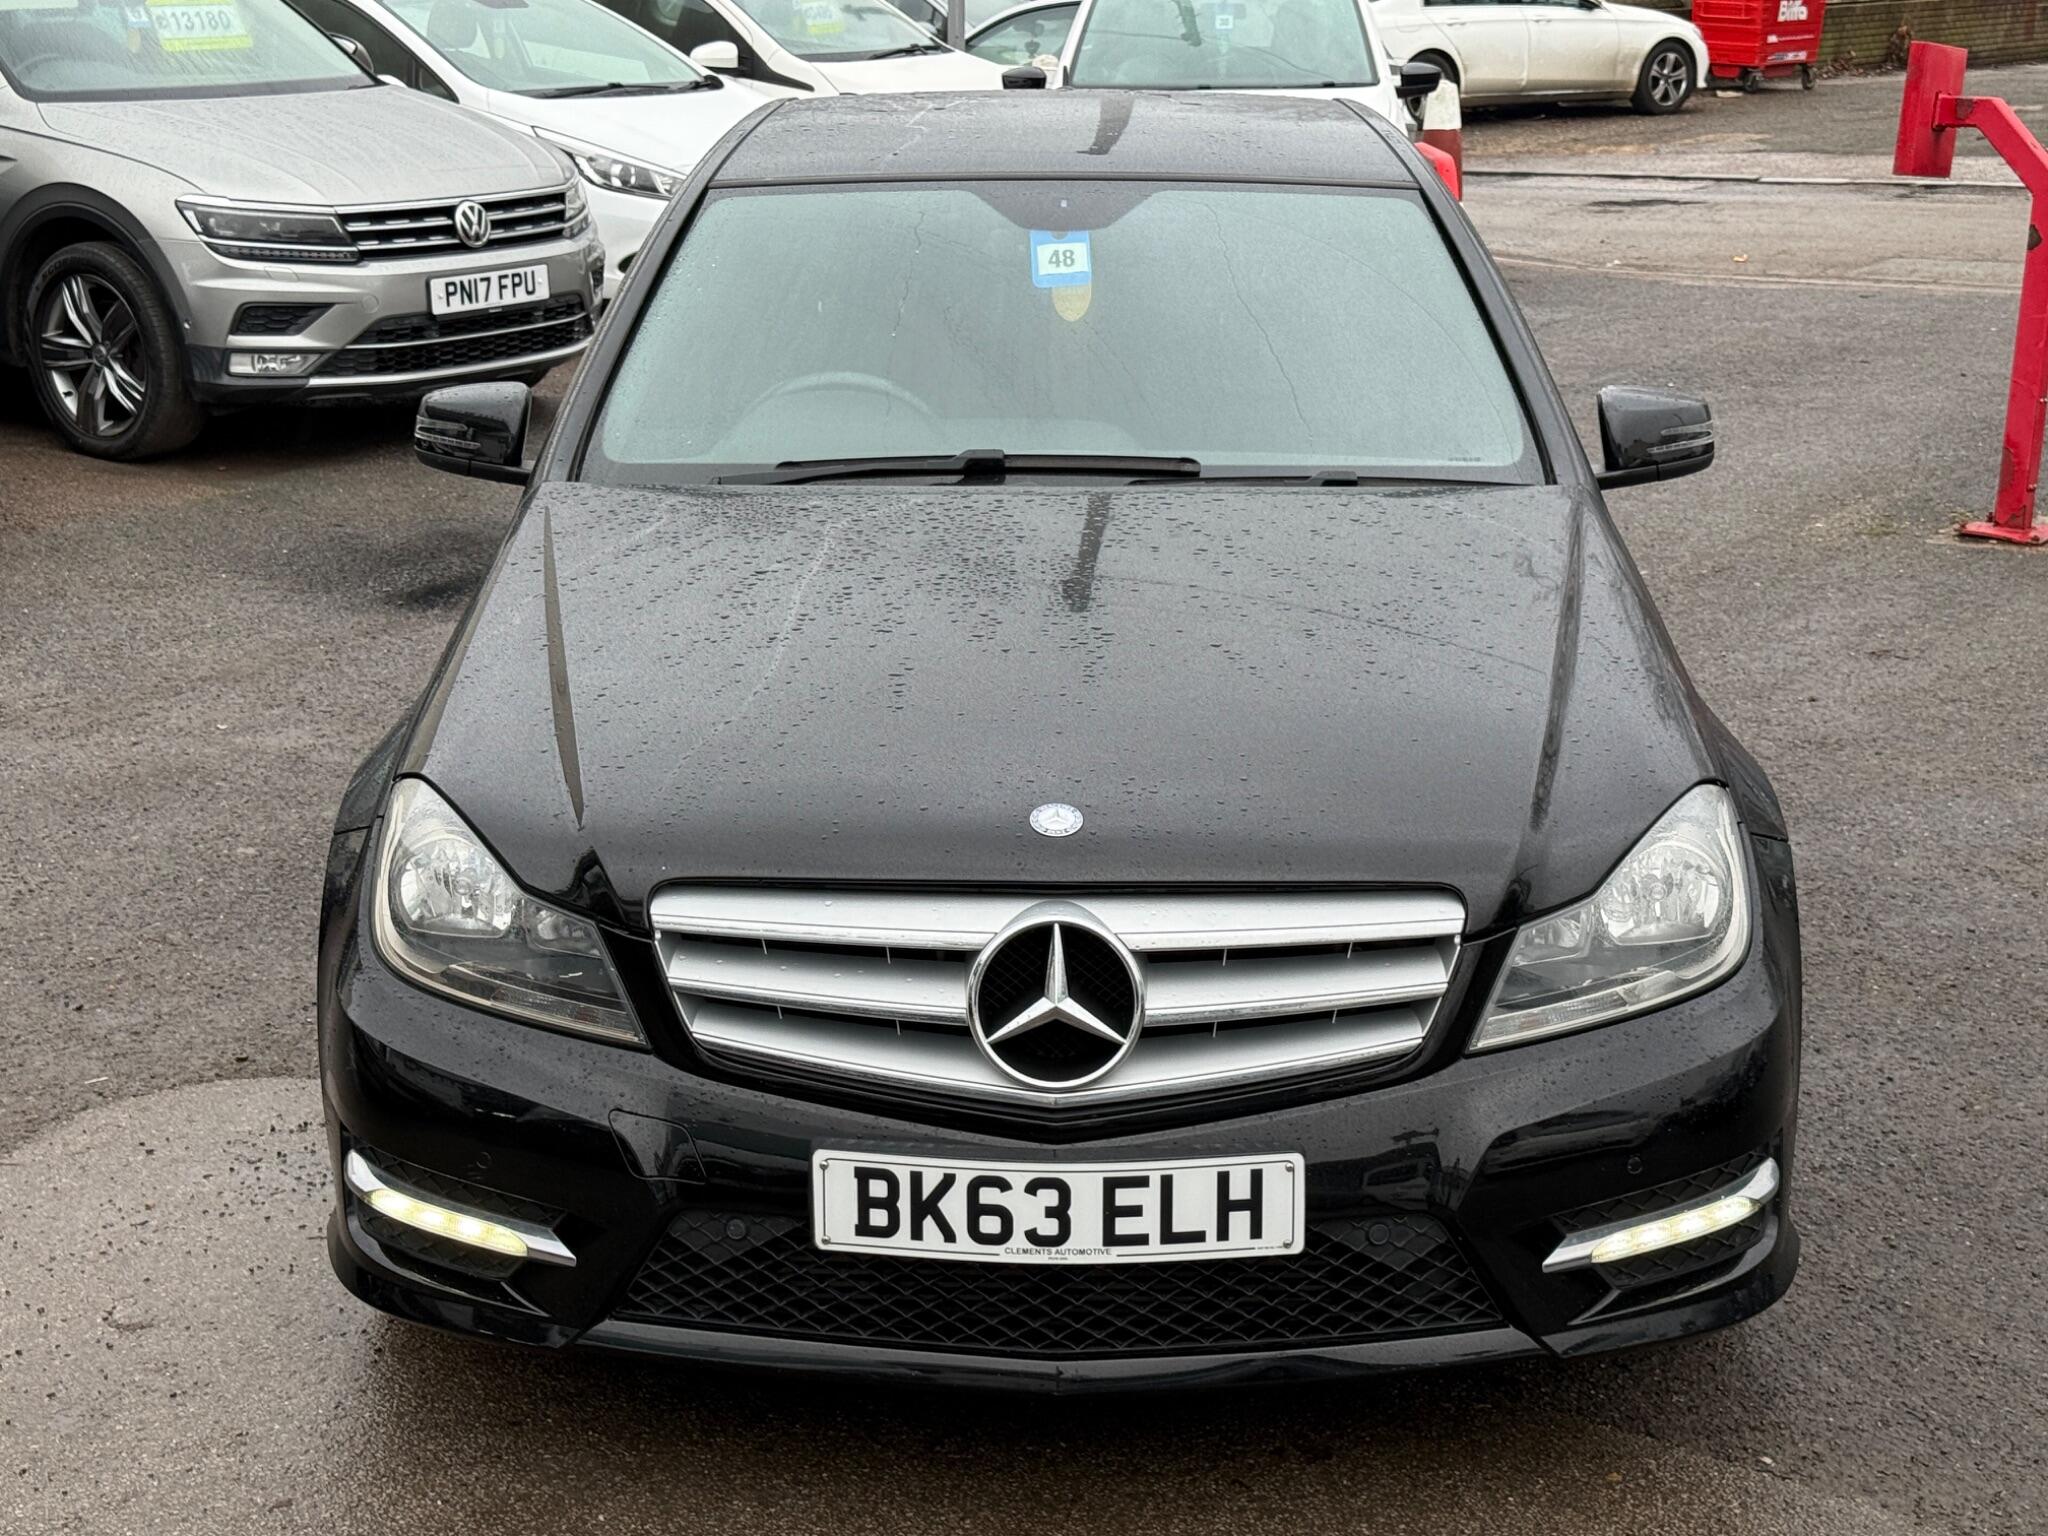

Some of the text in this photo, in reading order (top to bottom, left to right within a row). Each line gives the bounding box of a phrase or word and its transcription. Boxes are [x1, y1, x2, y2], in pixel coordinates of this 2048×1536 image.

[1047, 249, 1076, 268] 48
[444, 270, 537, 308] PN17 FPU
[854, 1165, 1263, 1248] BK63 ELH
[1004, 1246, 1113, 1257] CLEMENTS AUTOMOTIVE
